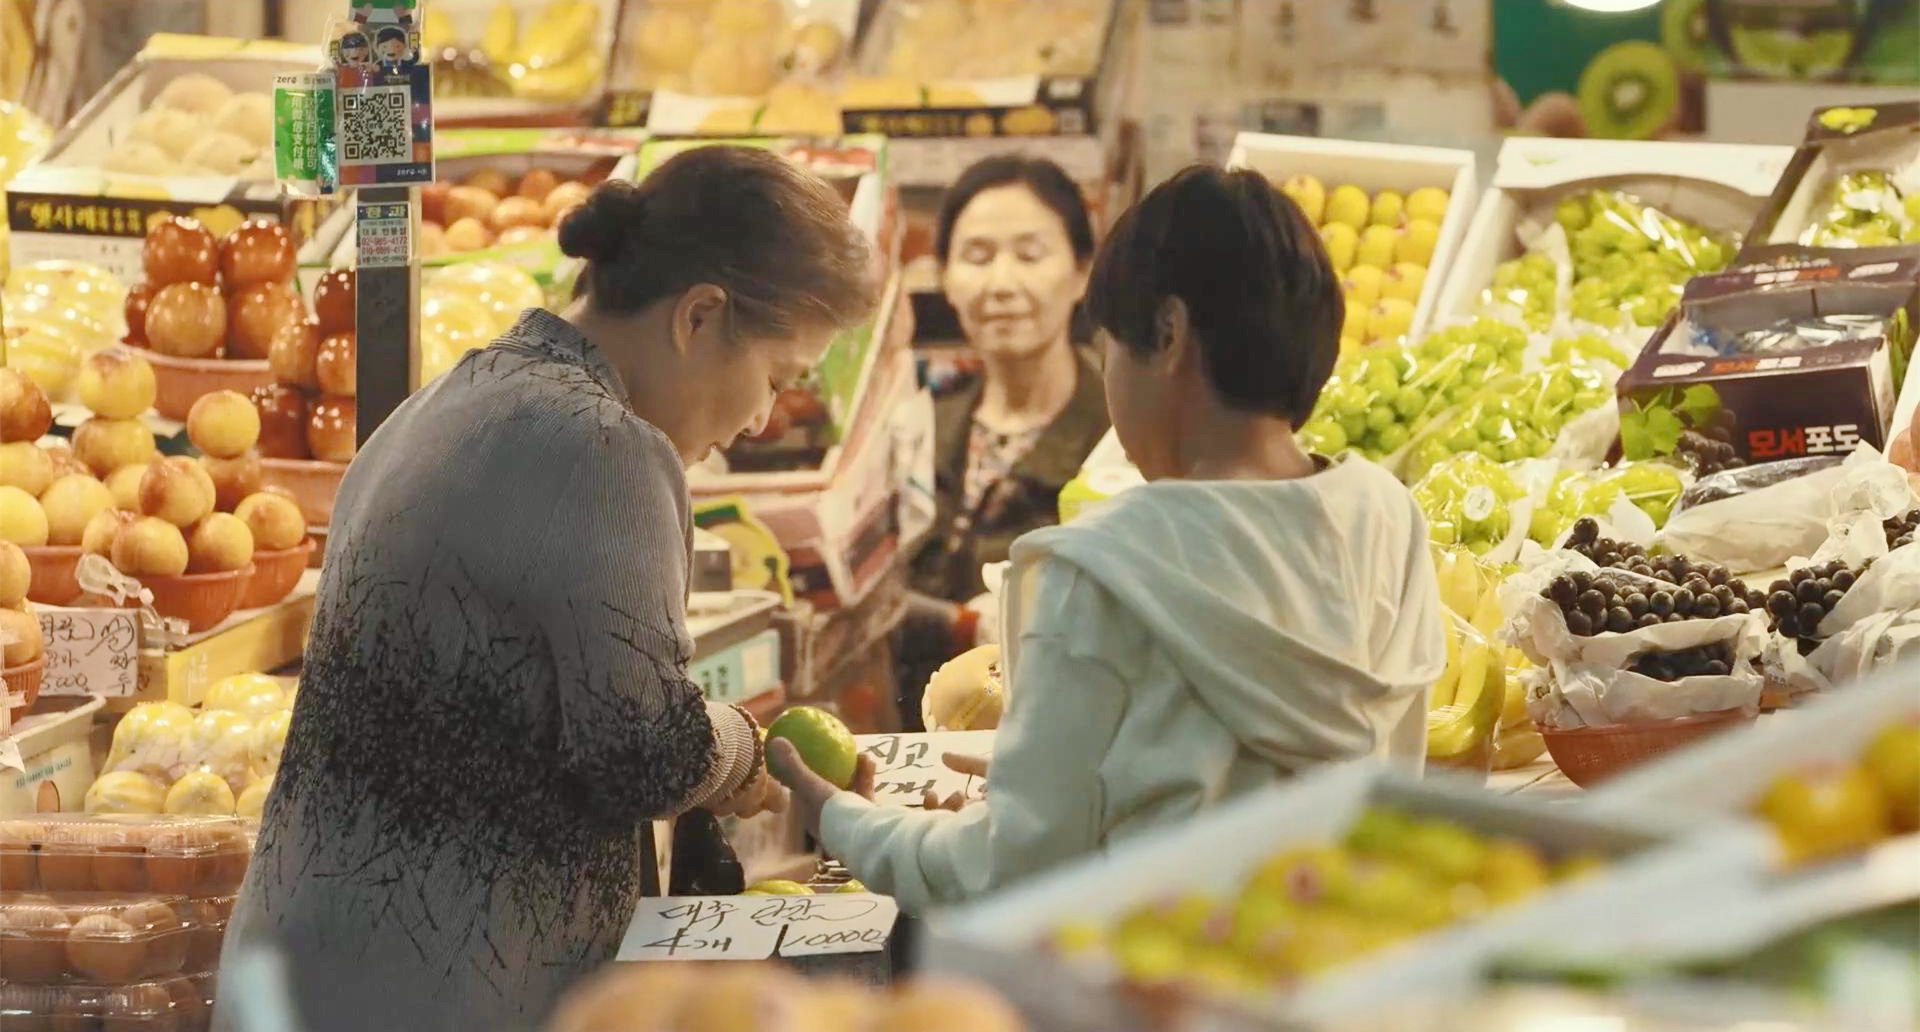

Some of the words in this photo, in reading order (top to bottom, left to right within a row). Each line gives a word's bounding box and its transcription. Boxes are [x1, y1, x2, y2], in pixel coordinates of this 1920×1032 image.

[277, 75, 297, 84] zero
[1748, 424, 1860, 456] 모서포도
[658, 900, 739, 932] 대추
